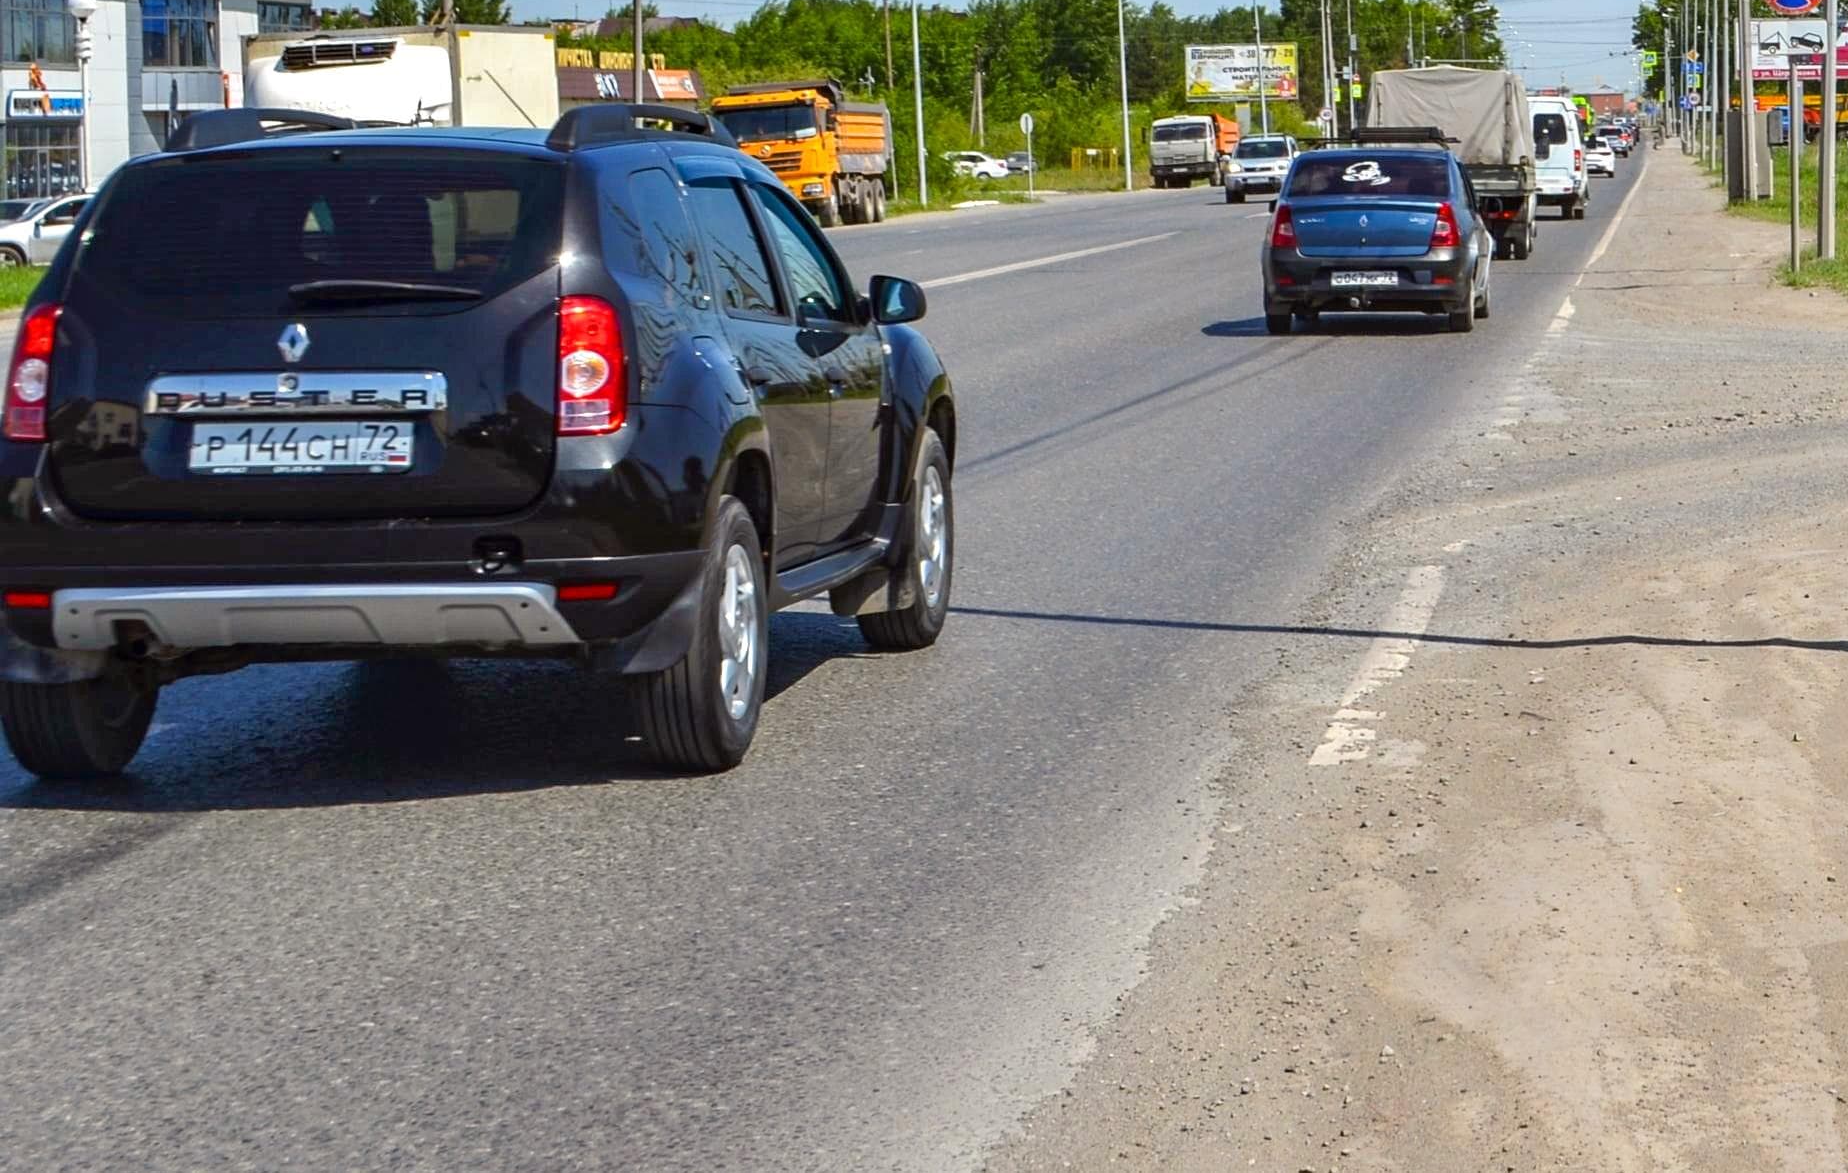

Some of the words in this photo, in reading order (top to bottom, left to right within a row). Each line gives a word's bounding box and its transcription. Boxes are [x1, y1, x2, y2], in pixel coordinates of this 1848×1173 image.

[157, 390, 428, 408] DUSTER
[365, 425, 399, 450] 72
[360, 452, 386, 461] RUS
